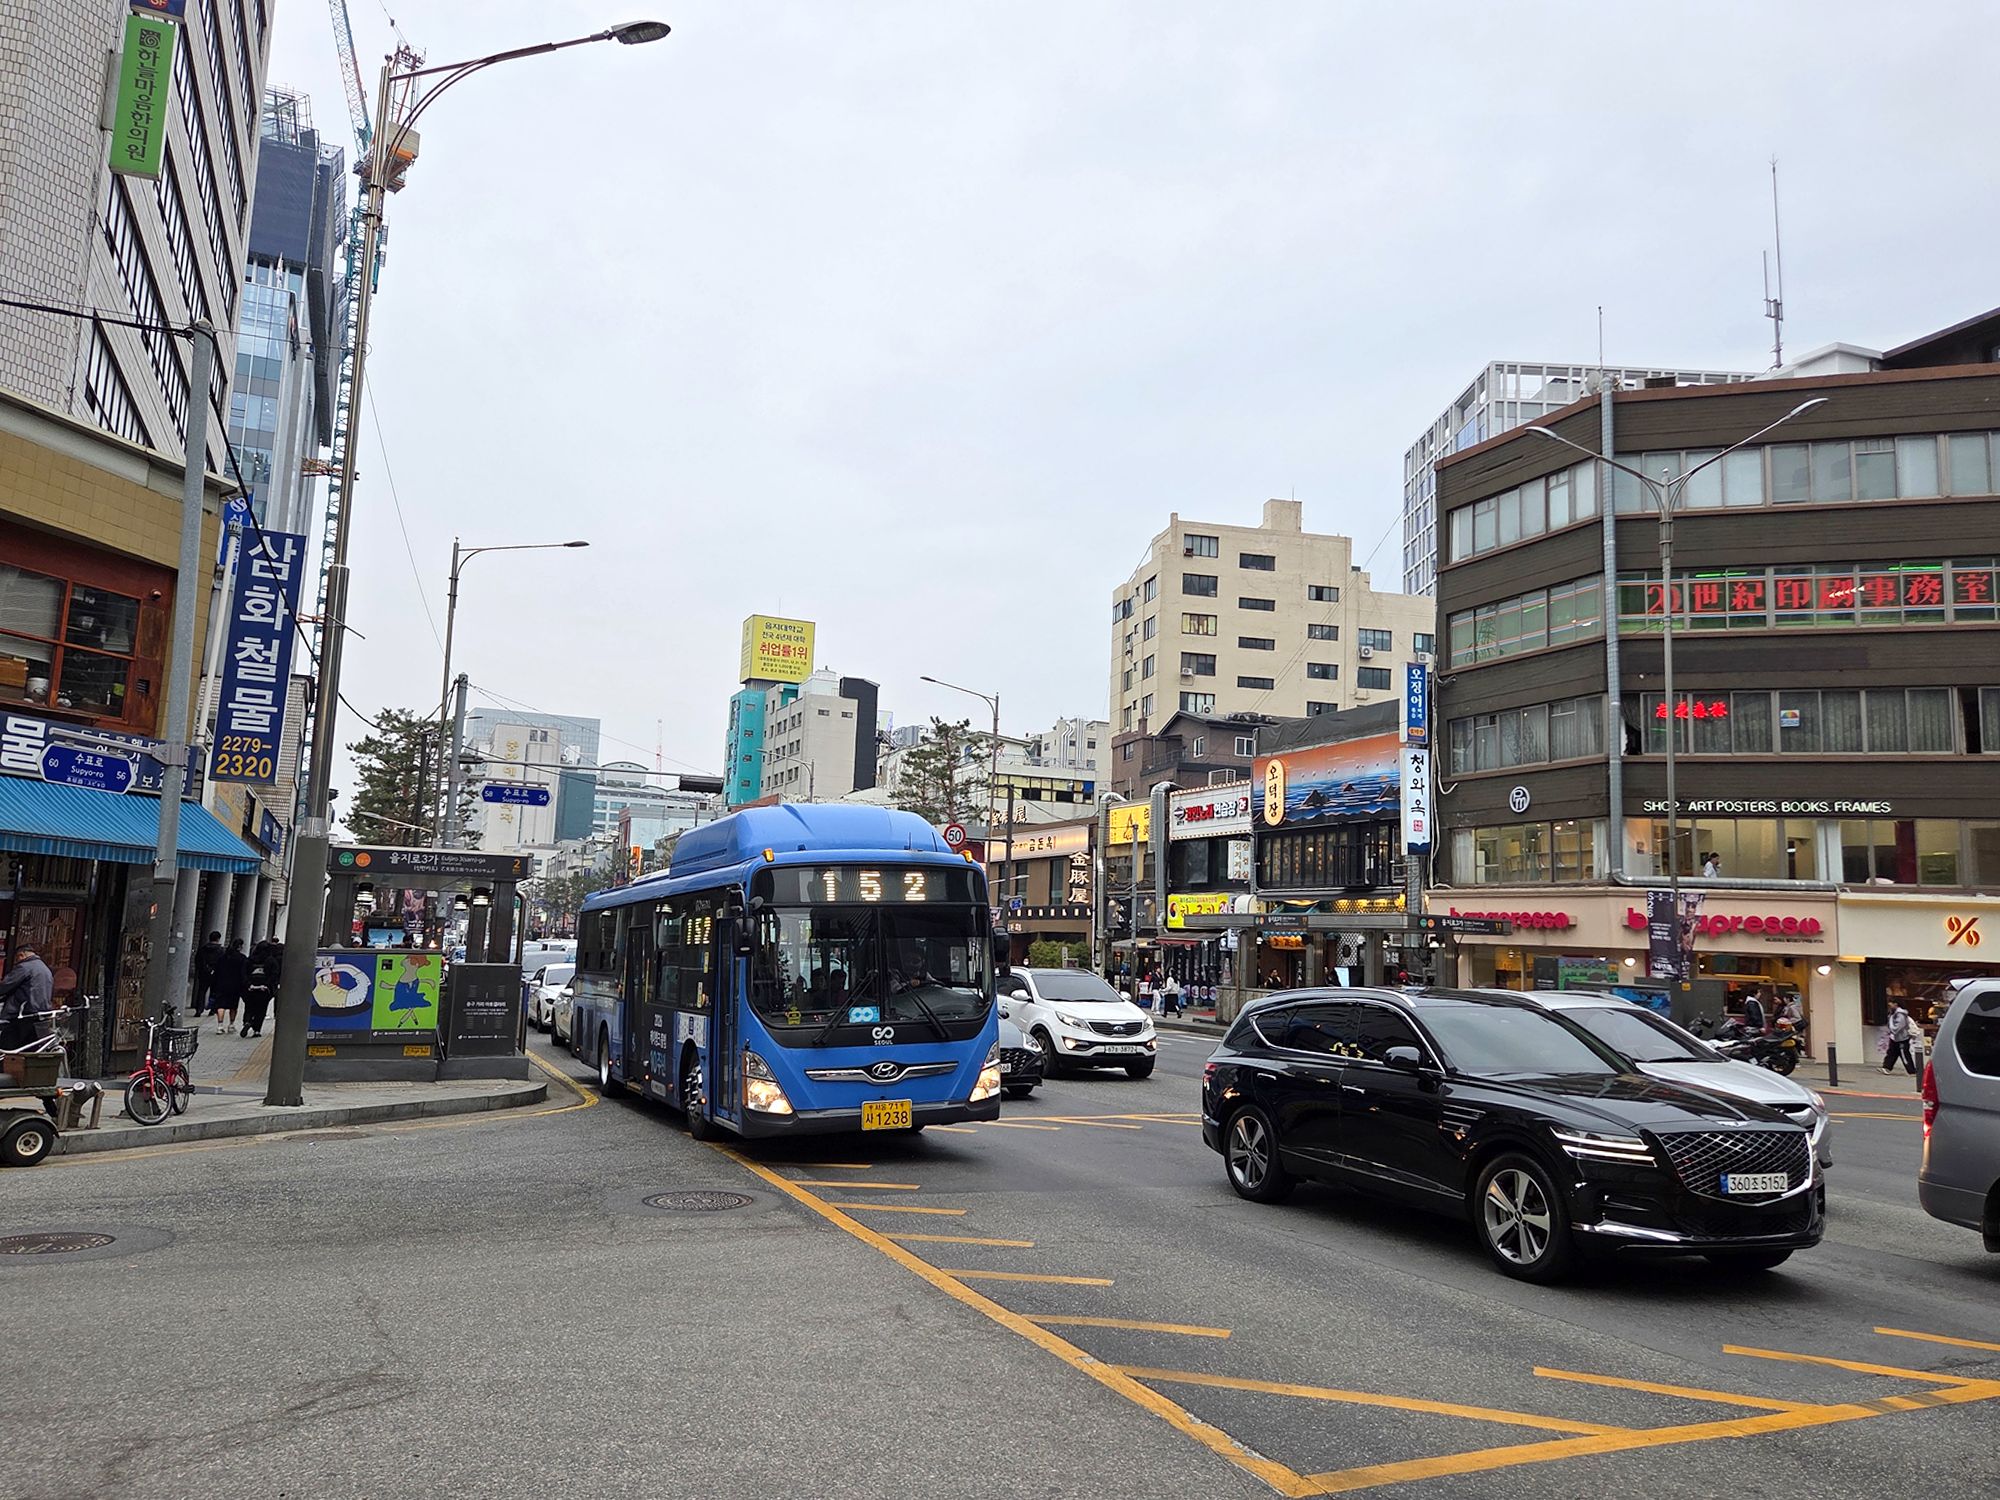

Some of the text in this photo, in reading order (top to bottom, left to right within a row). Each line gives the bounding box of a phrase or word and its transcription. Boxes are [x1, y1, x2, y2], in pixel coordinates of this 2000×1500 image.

[124, 48, 161, 163] 하늘마음한의원
[228, 535, 297, 734] 삼화철물
[1409, 668, 1424, 708] 오징어
[222, 736, 272, 753] 2279-
[48, 755, 126, 781] 60 수표로 56
[70, 765, 104, 778] Supyo-ro
[216, 755, 272, 778] 2320
[503, 788, 530, 798] 수표로
[1268, 766, 1279, 819] 오덕장
[1410, 754, 1426, 818] 청와옥
[1687, 801, 1714, 812] ART
[1715, 800, 1779, 813] POSTERS.
[1781, 800, 1831, 814] BOOKS.
[1834, 801, 1890, 813] FRAMES
[947, 829, 962, 843] 50
[389, 852, 438, 864] 을지로3가
[512, 858, 520, 868] 2
[822, 869, 927, 902] 152
[1068, 852, 1090, 904] 金豚屋
[687, 916, 711, 945] 152
[1627, 907, 1824, 938] bapresso
